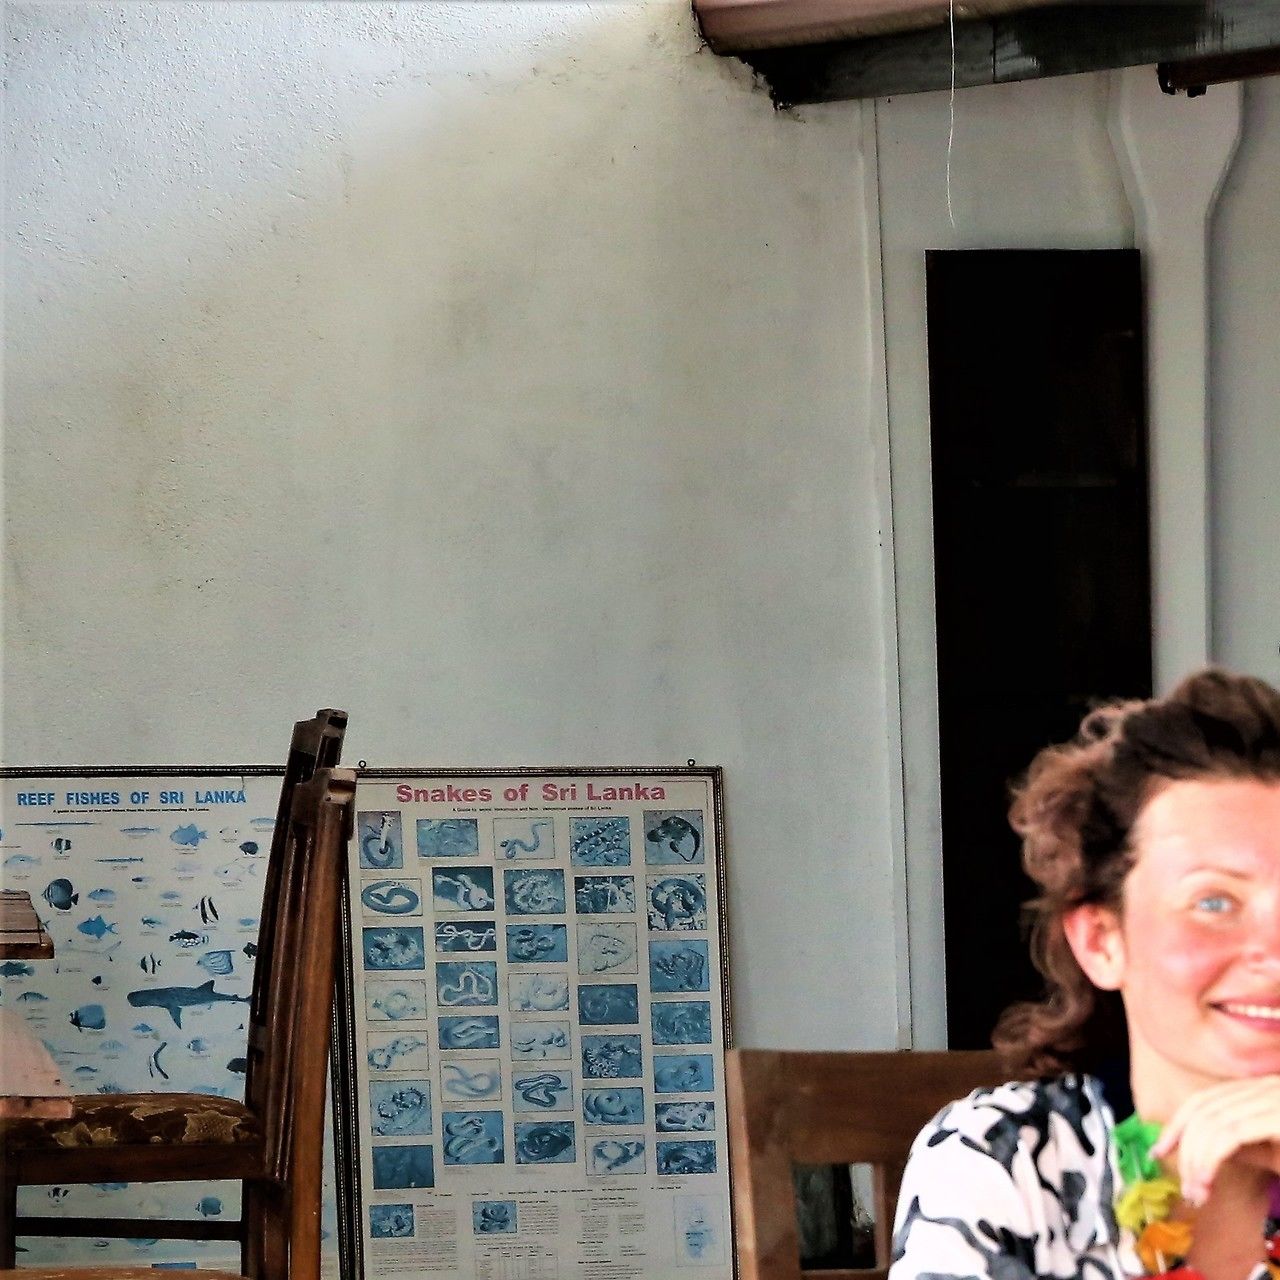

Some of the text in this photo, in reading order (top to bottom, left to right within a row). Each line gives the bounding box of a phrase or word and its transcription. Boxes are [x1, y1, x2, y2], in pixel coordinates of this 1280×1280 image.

[17, 790, 247, 806] REEF FISHES OF SRI LANKA
[396, 782, 666, 803] Snakes of Sri Lanka
